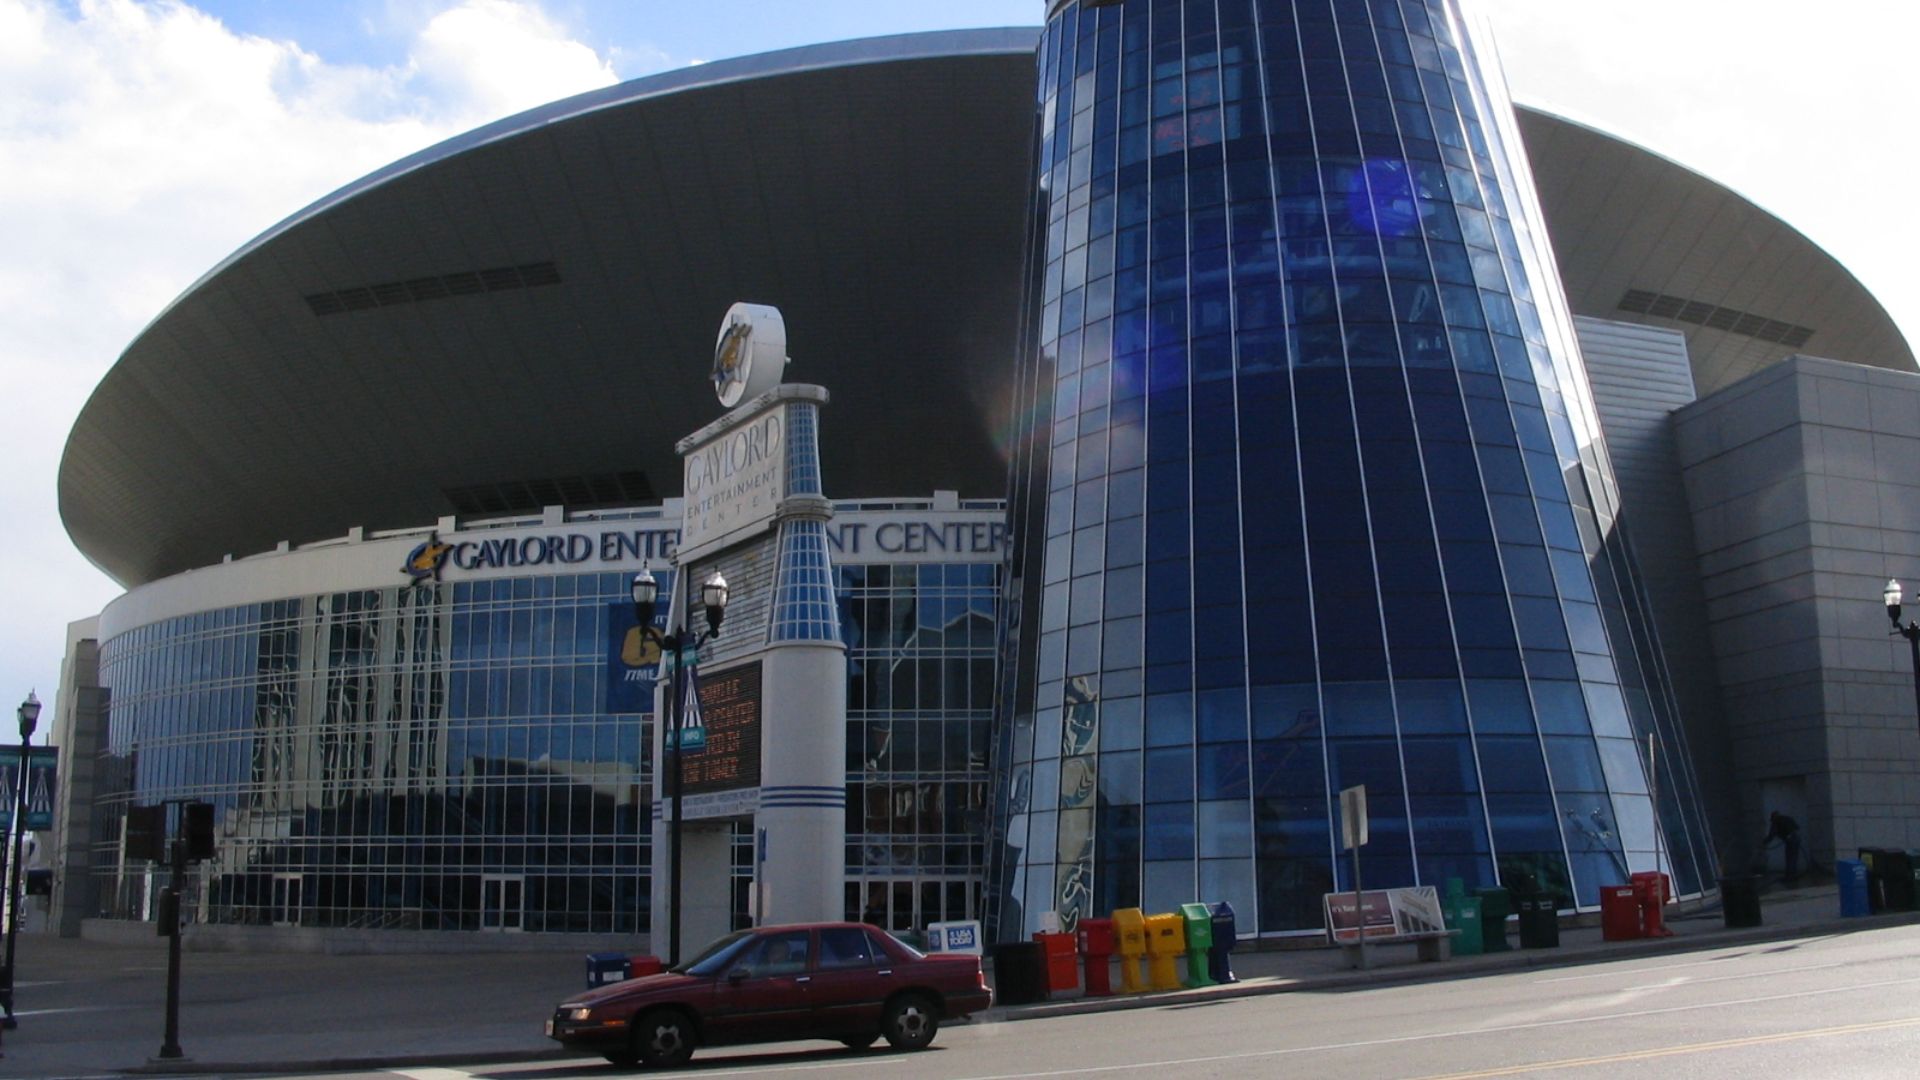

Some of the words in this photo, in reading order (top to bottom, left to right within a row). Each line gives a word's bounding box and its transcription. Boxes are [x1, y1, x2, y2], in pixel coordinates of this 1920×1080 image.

[687, 415, 780, 496] GAYLORD
[687, 467, 776, 519] ENTERTAINMENT
[453, 534, 593, 570] GAYLORD
